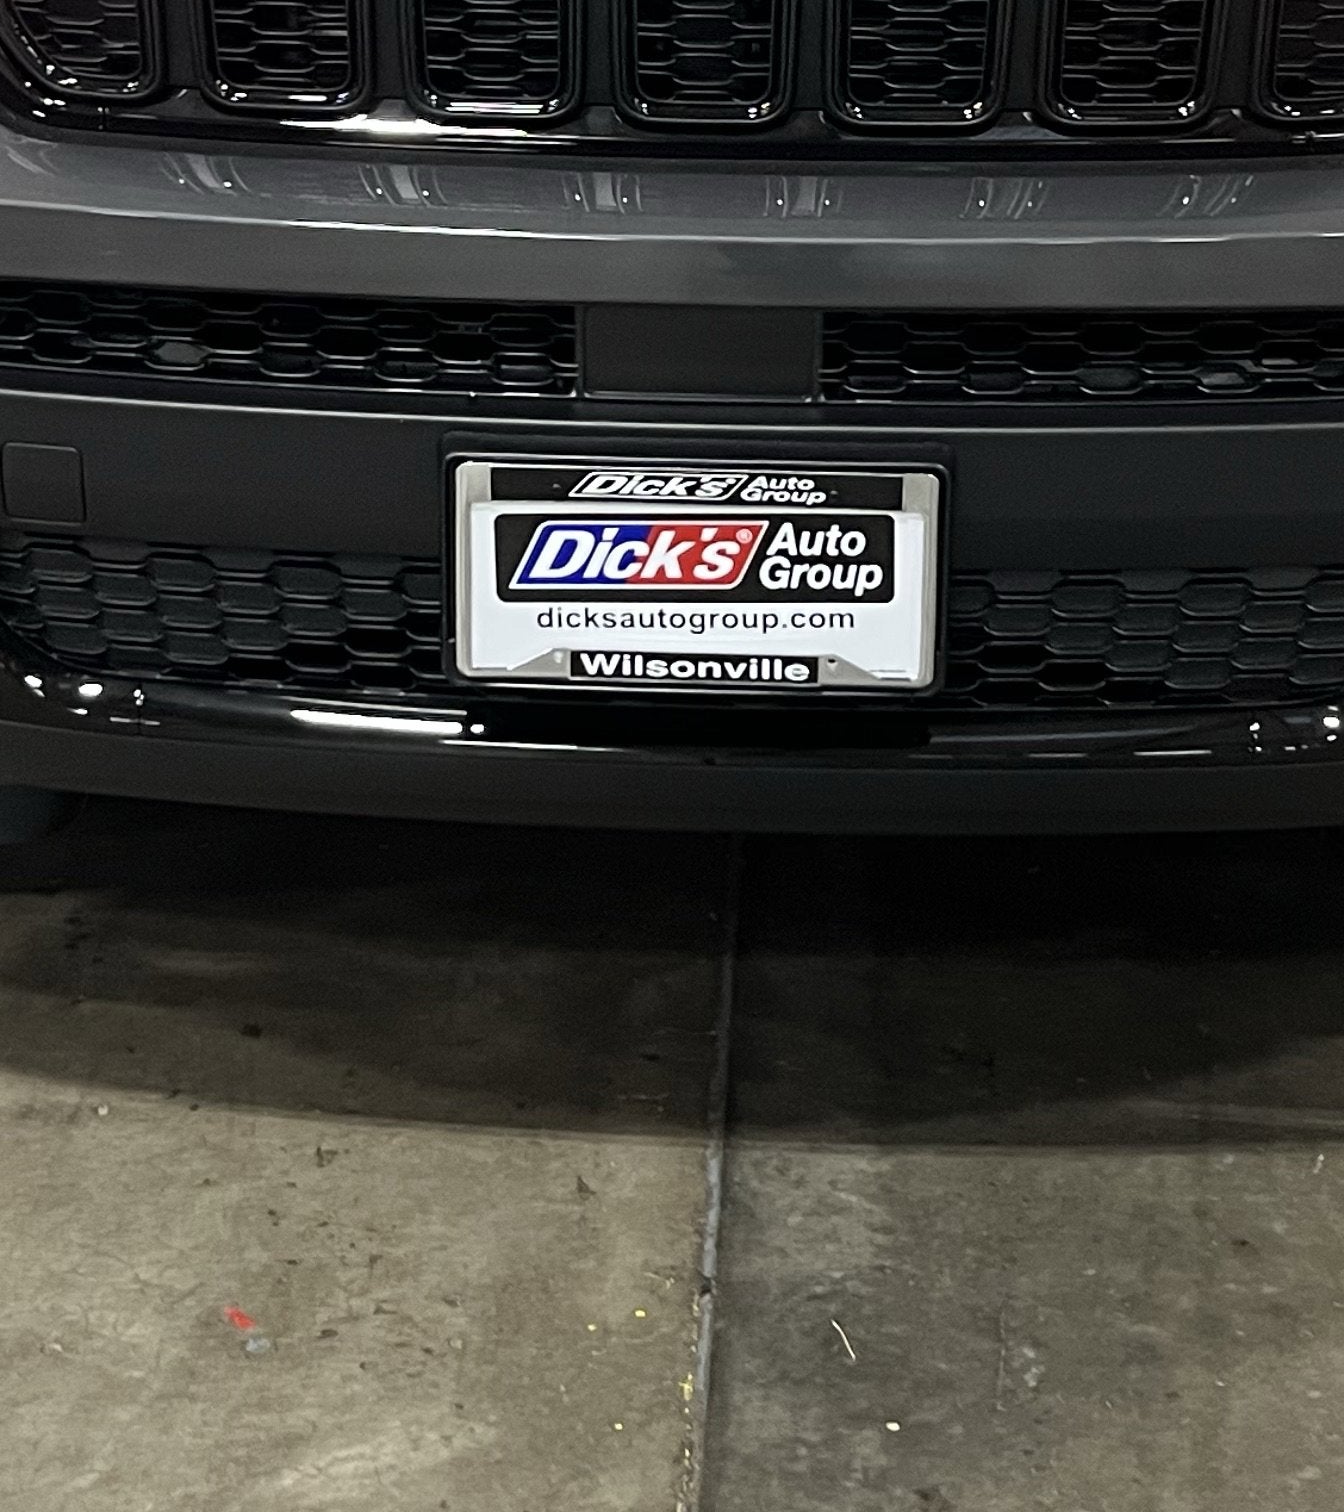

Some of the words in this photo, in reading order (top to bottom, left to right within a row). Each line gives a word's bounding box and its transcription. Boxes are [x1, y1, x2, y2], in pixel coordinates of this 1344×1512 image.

[740, 488, 827, 505] Group
[749, 475, 816, 491] Auto
[766, 522, 867, 558] Auto
[759, 555, 884, 596] Group
[536, 606, 855, 634] dicksautogroup.com
[580, 652, 810, 682] Wilsonville
